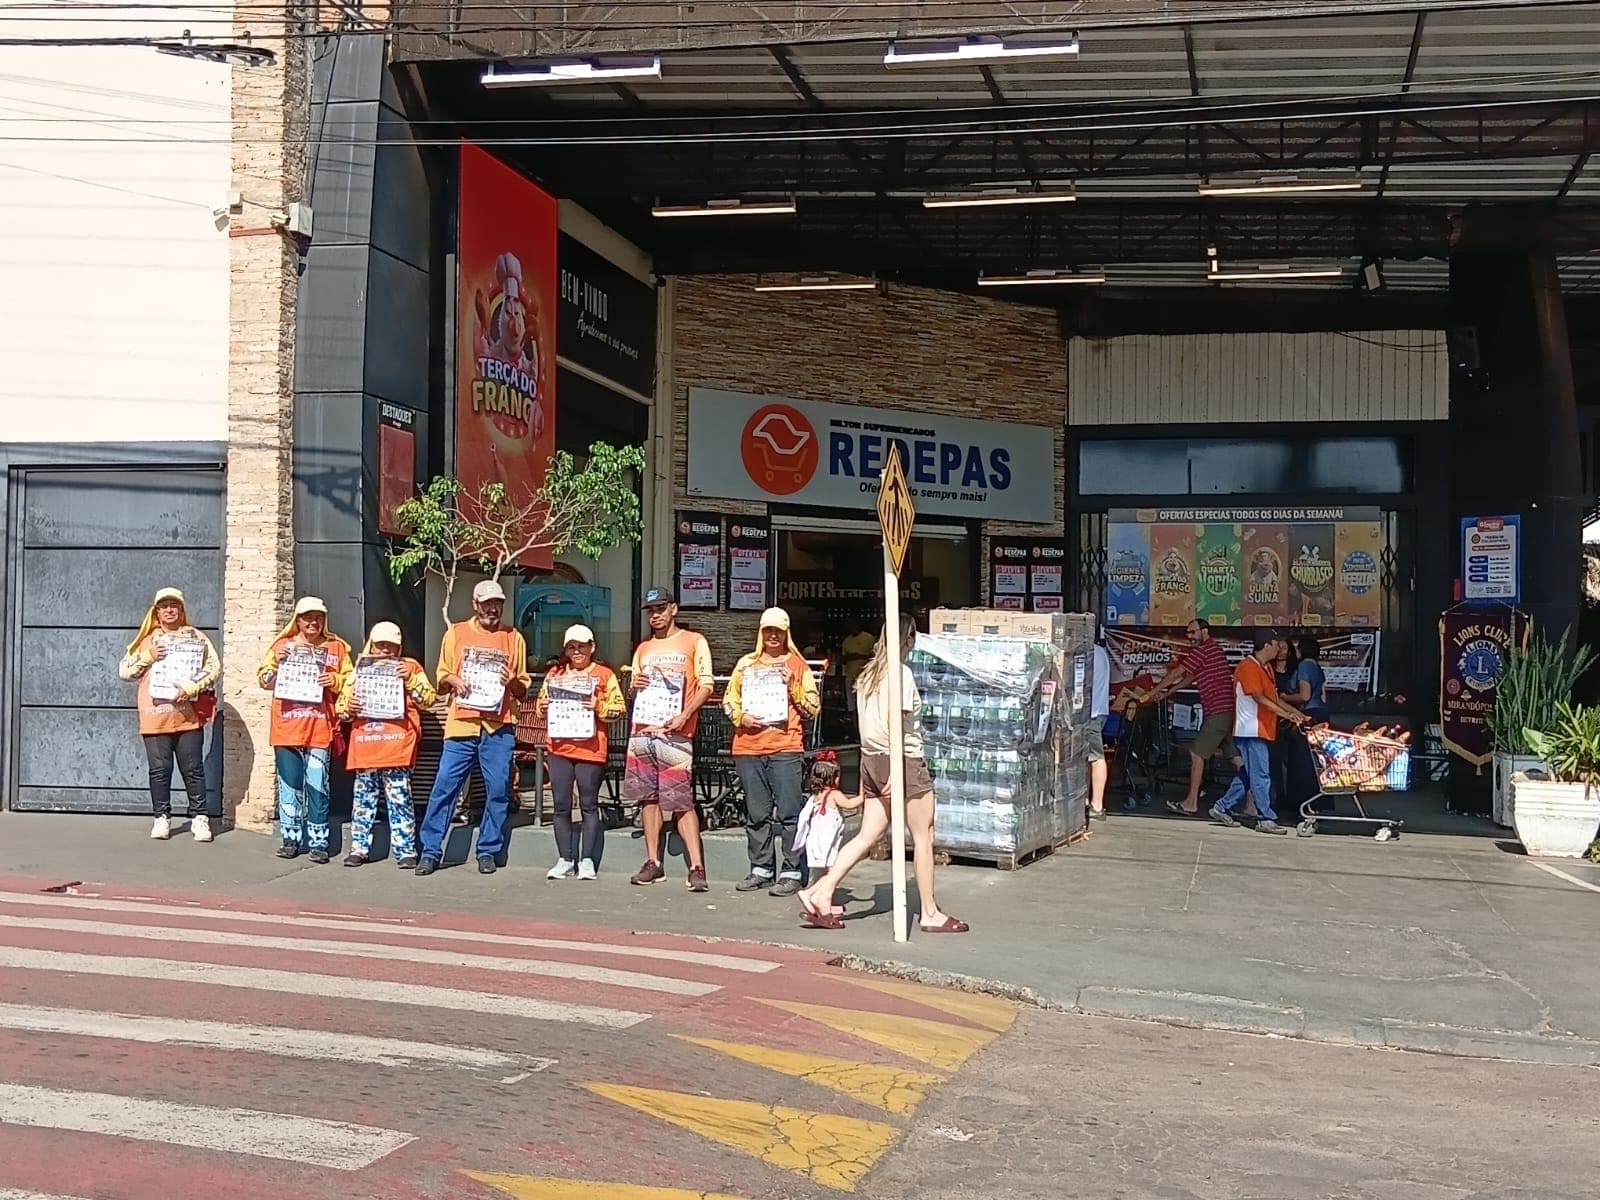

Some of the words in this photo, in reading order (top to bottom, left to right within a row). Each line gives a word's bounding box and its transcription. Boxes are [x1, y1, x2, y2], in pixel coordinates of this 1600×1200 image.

[478, 357, 518, 387] TERÇA
[520, 371, 537, 398] DO
[829, 431, 1012, 490] REDEPAS
[920, 487, 958, 502] sempre
[959, 491, 988, 503] mais!
[1159, 510, 1194, 520] OFERTAS
[1231, 510, 1260, 520] TODOS
[1260, 510, 1272, 519] OS
[1273, 510, 1292, 519] DIAS
[1293, 510, 1306, 519] DA
[1306, 509, 1344, 519] SEMANA!
[1200, 565, 1236, 574] QUARTA
[1291, 566, 1334, 586] CHURRASCO
[1108, 574, 1145, 583] LIMPEZA
[779, 581, 836, 599] CORTES
[1155, 582, 1191, 593] FRANGO
[1249, 582, 1279, 592] QUINTA
[1453, 624, 1481, 647] LIONS
[1467, 640, 1497, 654] LIONS
[1122, 651, 1171, 664] PRÊMIOS
[1476, 656, 1489, 674] L
